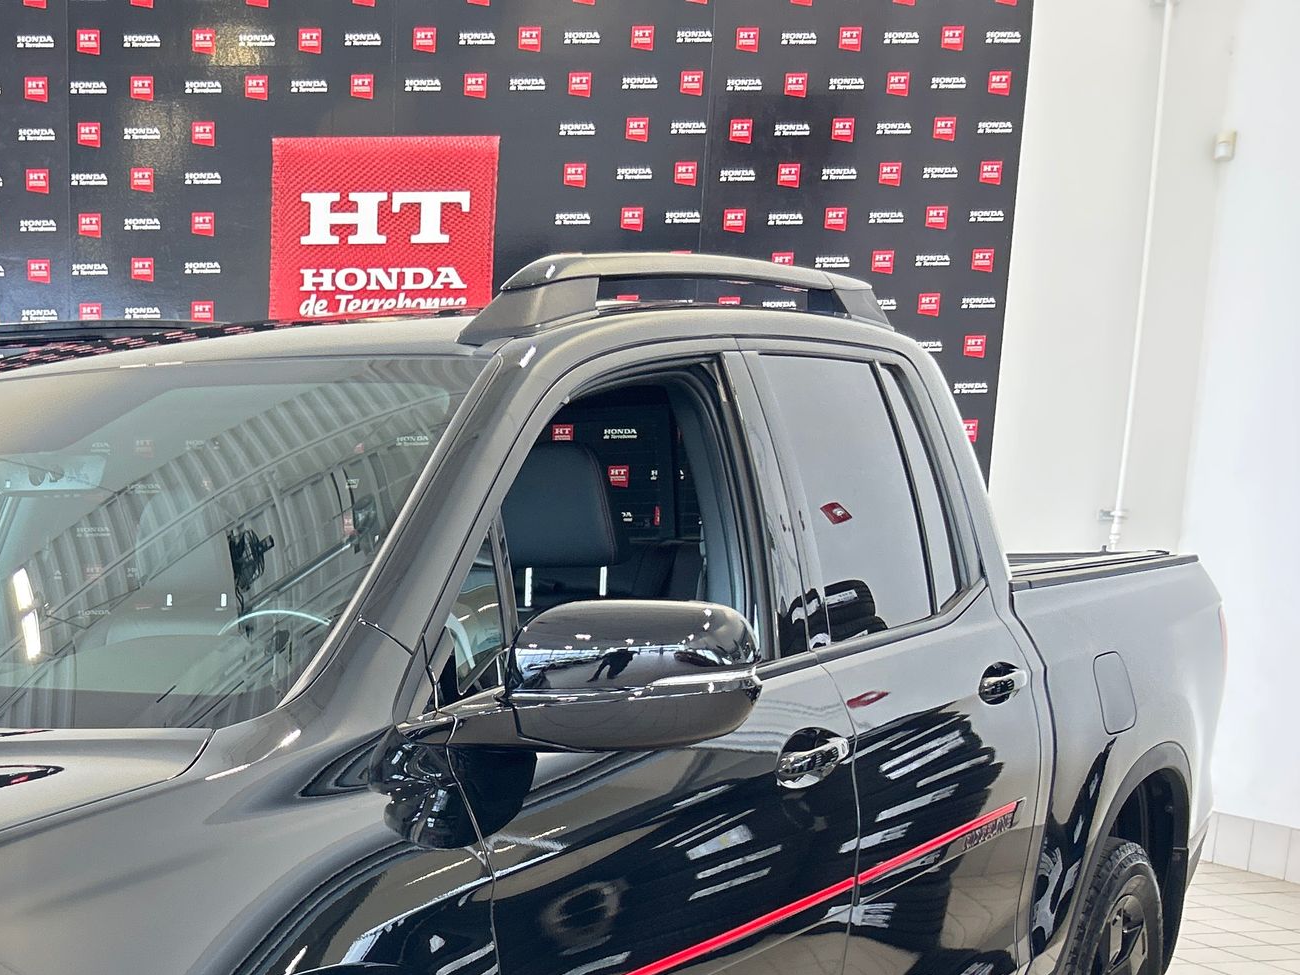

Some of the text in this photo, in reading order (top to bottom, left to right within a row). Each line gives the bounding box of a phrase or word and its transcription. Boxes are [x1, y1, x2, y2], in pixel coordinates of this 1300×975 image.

[345, 33, 381, 41] HONDA
[459, 32, 495, 40] HONDA
[677, 30, 712, 38] HONDA
[781, 32, 817, 40] HONDA
[986, 31, 1021, 39] HONDA
[17, 35, 54, 43] HONDA
[70, 81, 107, 89] HONDA
[291, 80, 327, 88] HONDA
[510, 78, 545, 86] HONDA
[124, 127, 160, 135] HONDA
[560, 123, 595, 131] HONDA
[18, 128, 55, 136] HONDA
[71, 173, 107, 181] HONDA
[185, 172, 221, 180] HONDA
[720, 169, 755, 177] HONDA
[300, 191, 471, 245] HT
[665, 211, 700, 219] HONDA
[72, 263, 108, 271] HONDA
[299, 267, 467, 292] HONDA
[299, 294, 327, 317] de
